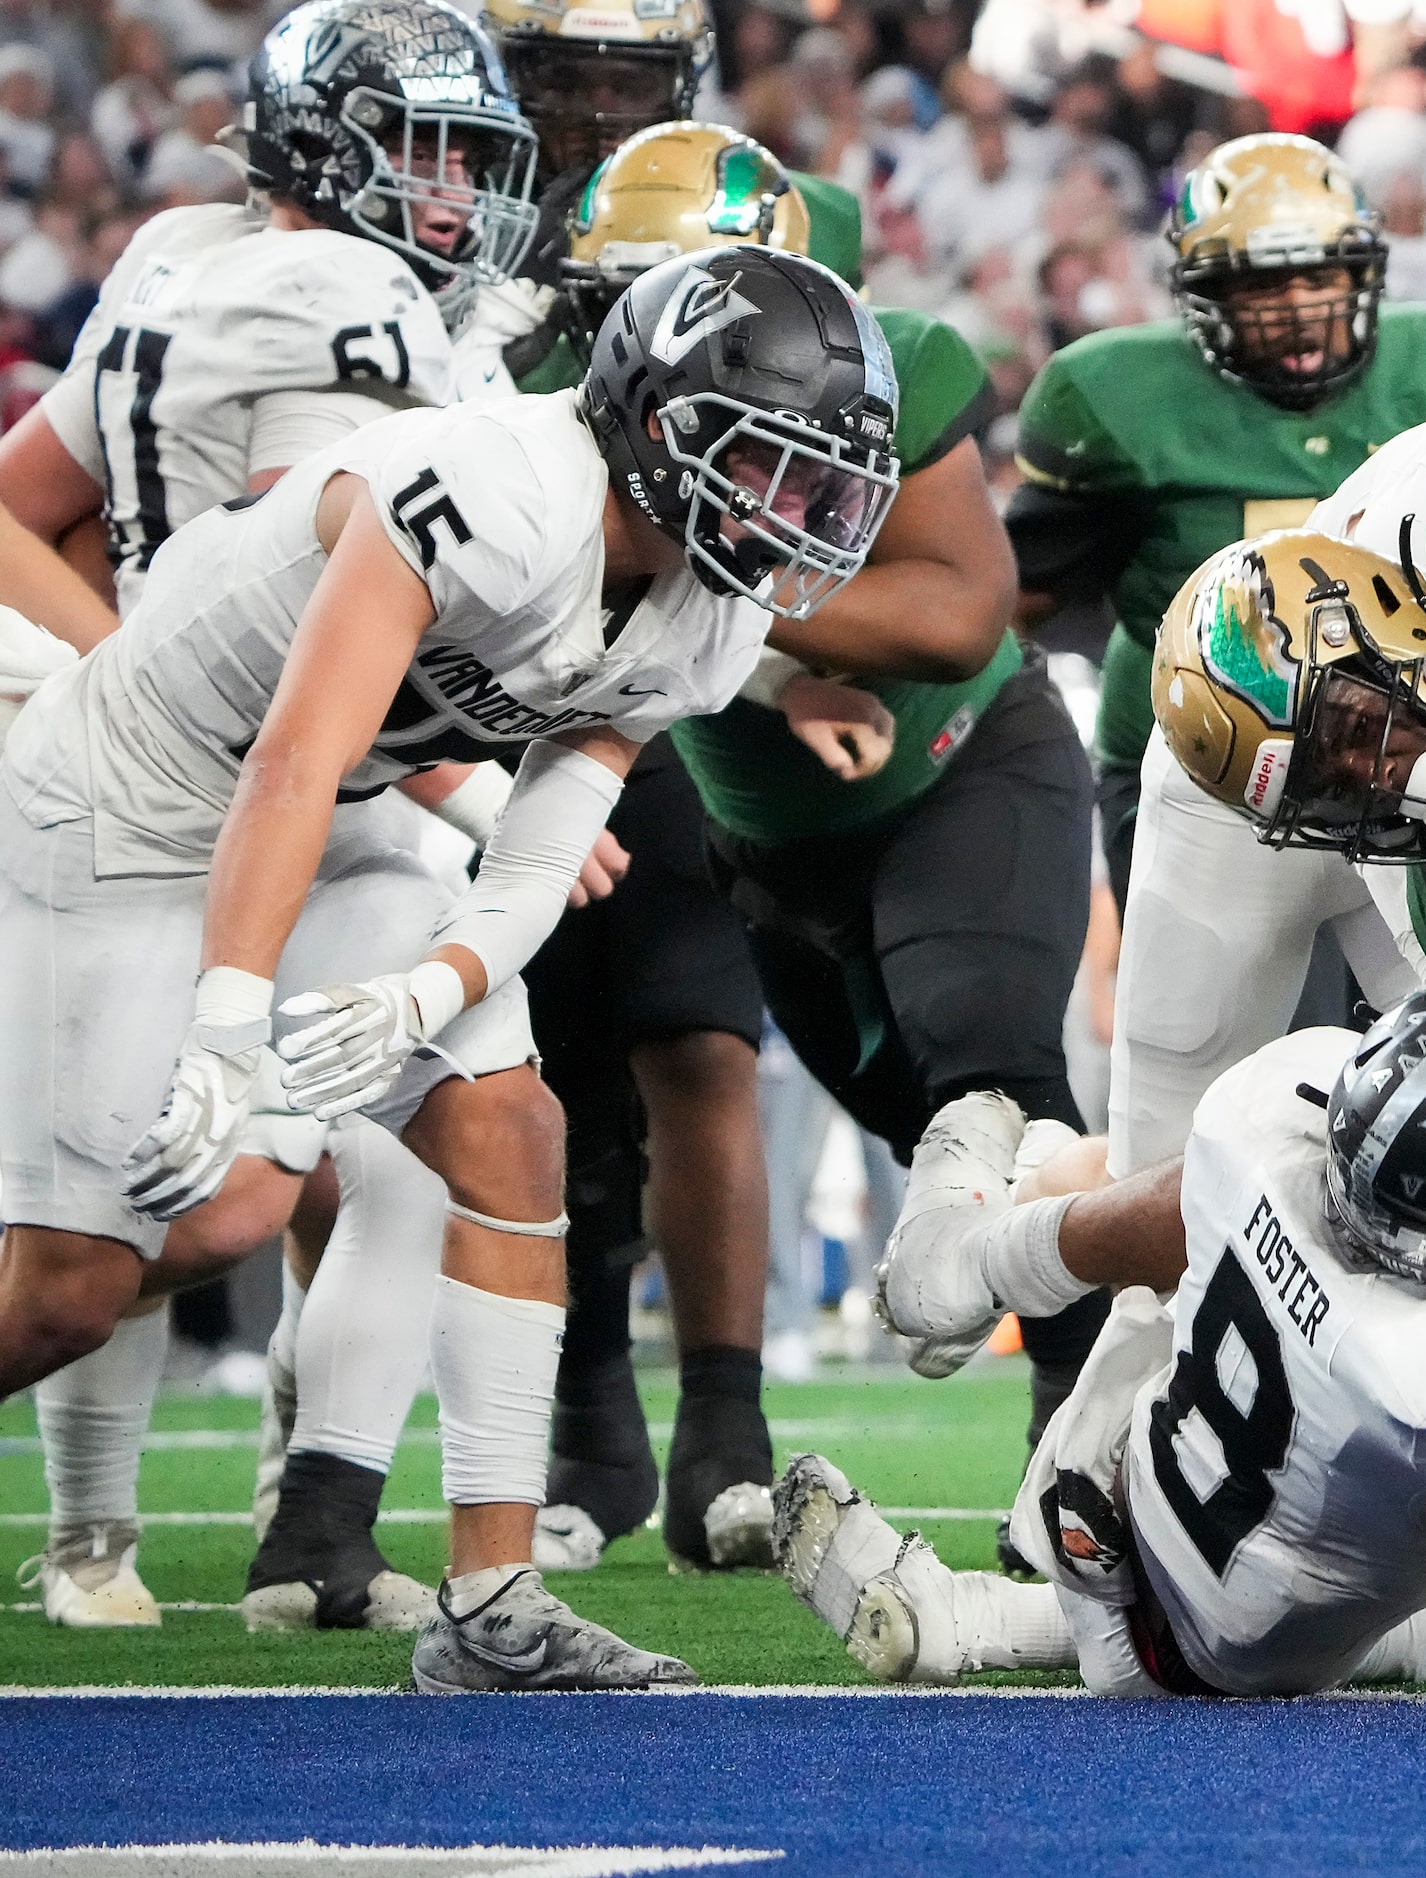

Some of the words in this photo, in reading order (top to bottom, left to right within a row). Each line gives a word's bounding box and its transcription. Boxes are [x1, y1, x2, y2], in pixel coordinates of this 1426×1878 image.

[860, 415, 888, 440] VIPERS
[392, 466, 474, 571] 15
[1244, 1194, 1331, 1347] FOSTER
[1149, 1244, 1298, 1580] 8
